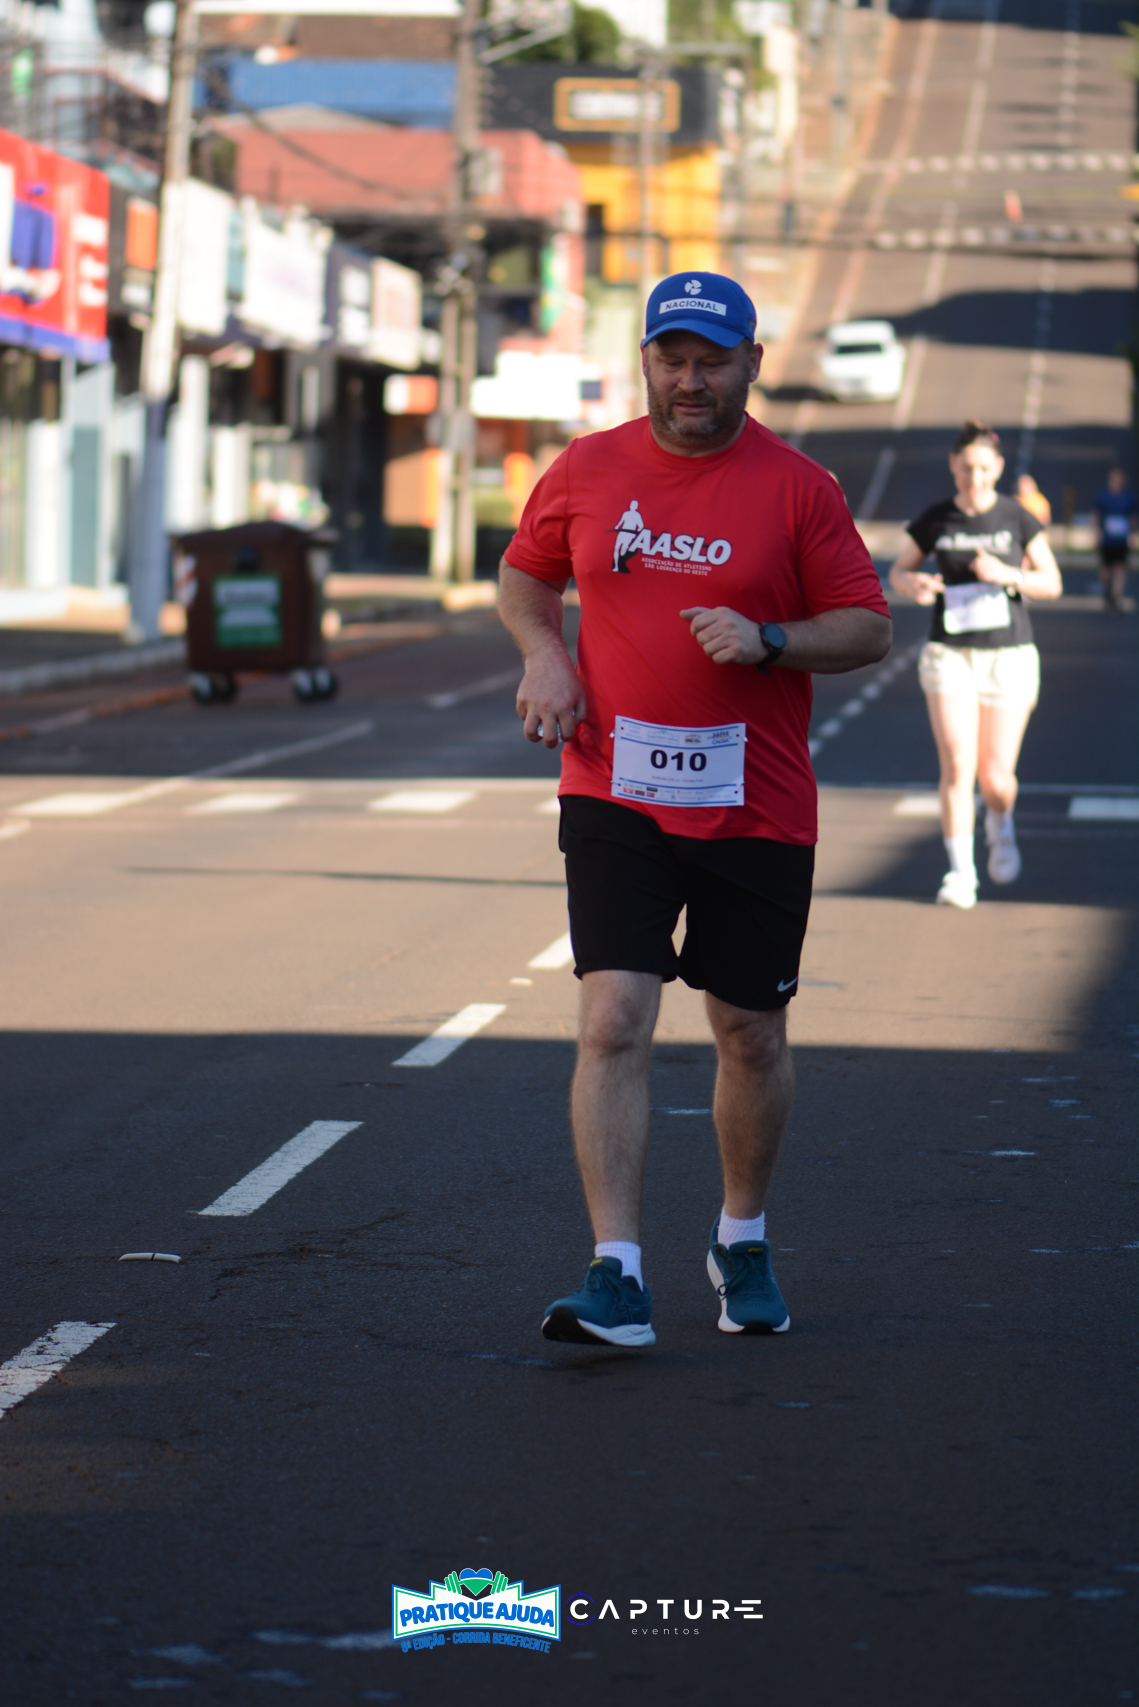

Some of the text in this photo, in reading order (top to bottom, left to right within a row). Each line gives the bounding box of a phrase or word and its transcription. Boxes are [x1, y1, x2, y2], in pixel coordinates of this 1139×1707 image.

[664, 300, 719, 312] NACIONAL
[627, 528, 732, 566] AASLO
[641, 557, 674, 567] ASSOCIAÇÃO
[683, 563, 712, 572] ATLETISMO
[644, 562, 655, 570] SÃO
[656, 564, 683, 574] LOURENÇO
[650, 749, 707, 772] 010
